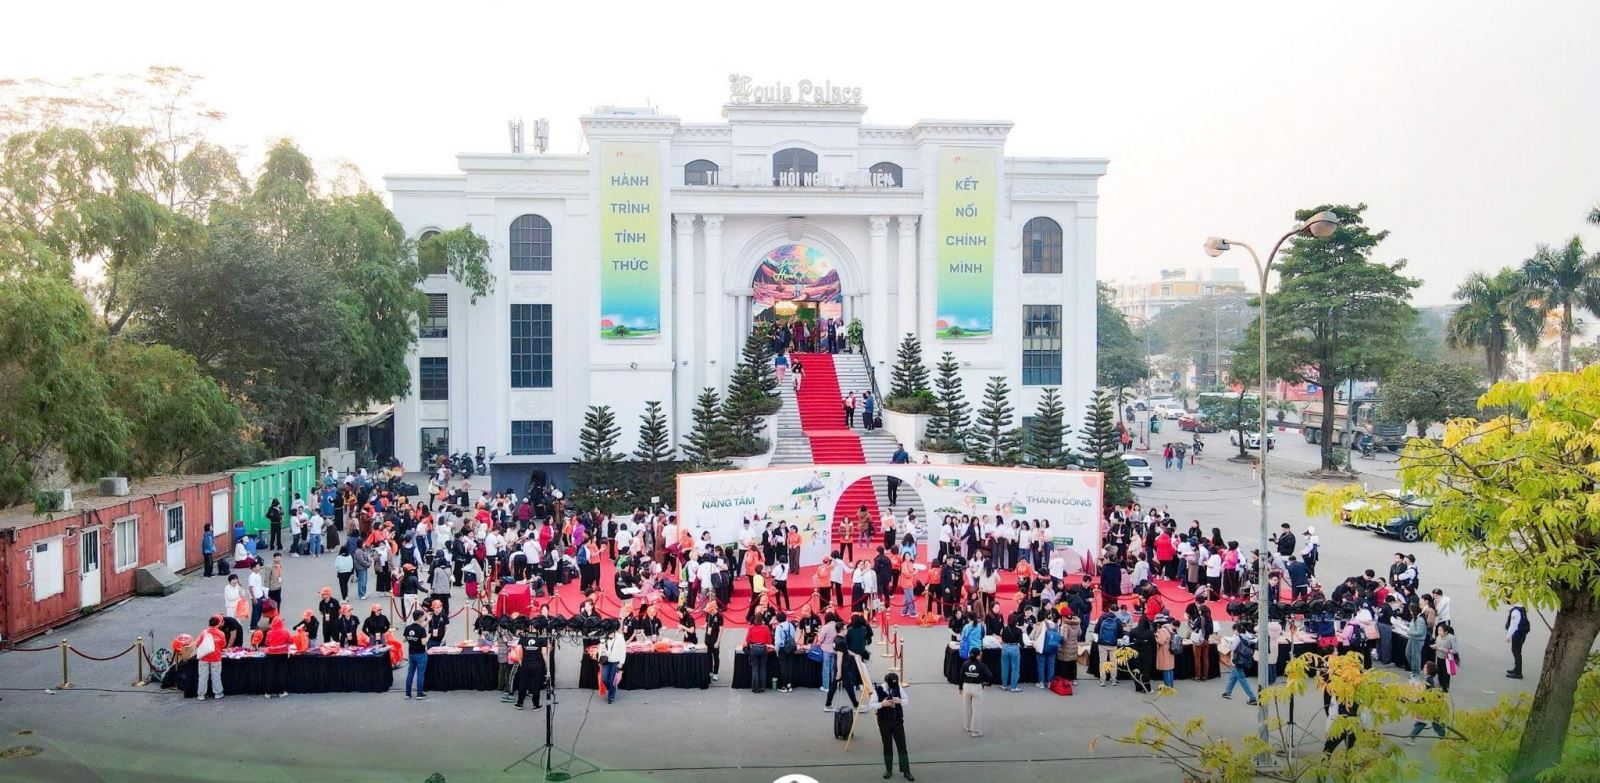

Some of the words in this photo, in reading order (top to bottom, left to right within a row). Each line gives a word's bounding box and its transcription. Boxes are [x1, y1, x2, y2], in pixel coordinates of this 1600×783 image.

[728, 74, 791, 105] Louis
[798, 79, 862, 104] Palace
[611, 172, 649, 186] HÀNH
[955, 176, 979, 191] KẾT
[610, 199, 650, 214] TRÌNH
[955, 203, 978, 218] NỐI
[945, 233, 987, 246] CHÍNH
[611, 257, 649, 271] THỨC
[949, 260, 982, 274] MÌNH
